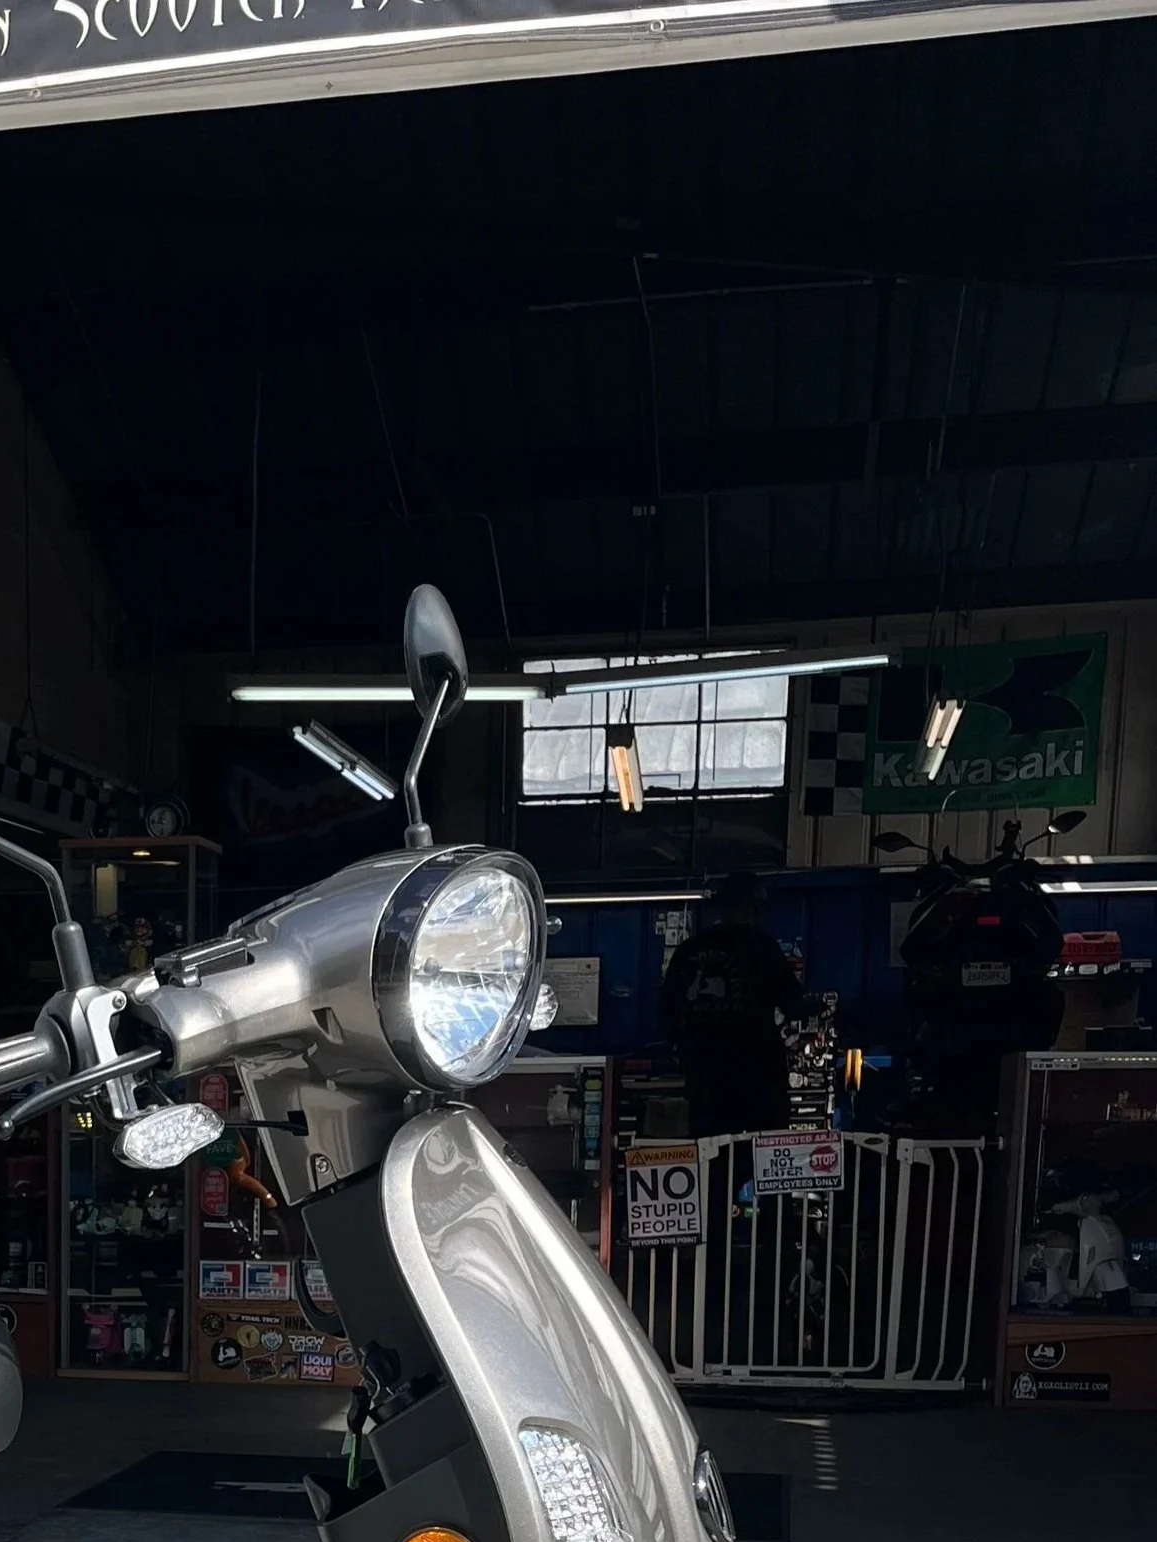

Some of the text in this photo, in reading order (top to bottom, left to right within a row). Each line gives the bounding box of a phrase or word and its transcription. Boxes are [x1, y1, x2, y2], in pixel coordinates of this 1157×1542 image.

[872, 740, 1083, 788] Kawasaki
[756, 1136, 812, 1146] RESTRICTED
[644, 1149, 694, 1161] WARNING
[774, 1148, 790, 1157] DO
[771, 1157, 794, 1167] NOT
[811, 1153, 836, 1166] STOP
[763, 1167, 803, 1177] ENTER
[630, 1166, 695, 1202] NO
[758, 1177, 838, 1191] EMPLOYEES ONLY
[631, 1202, 695, 1218] STUPID
[631, 1218, 697, 1234] PEOPLE
[631, 1238, 659, 1246] BEYOND
[676, 1236, 698, 1244] POINT
[302, 1354, 332, 1366] LIQUI
[302, 1366, 332, 1377] MOLY
